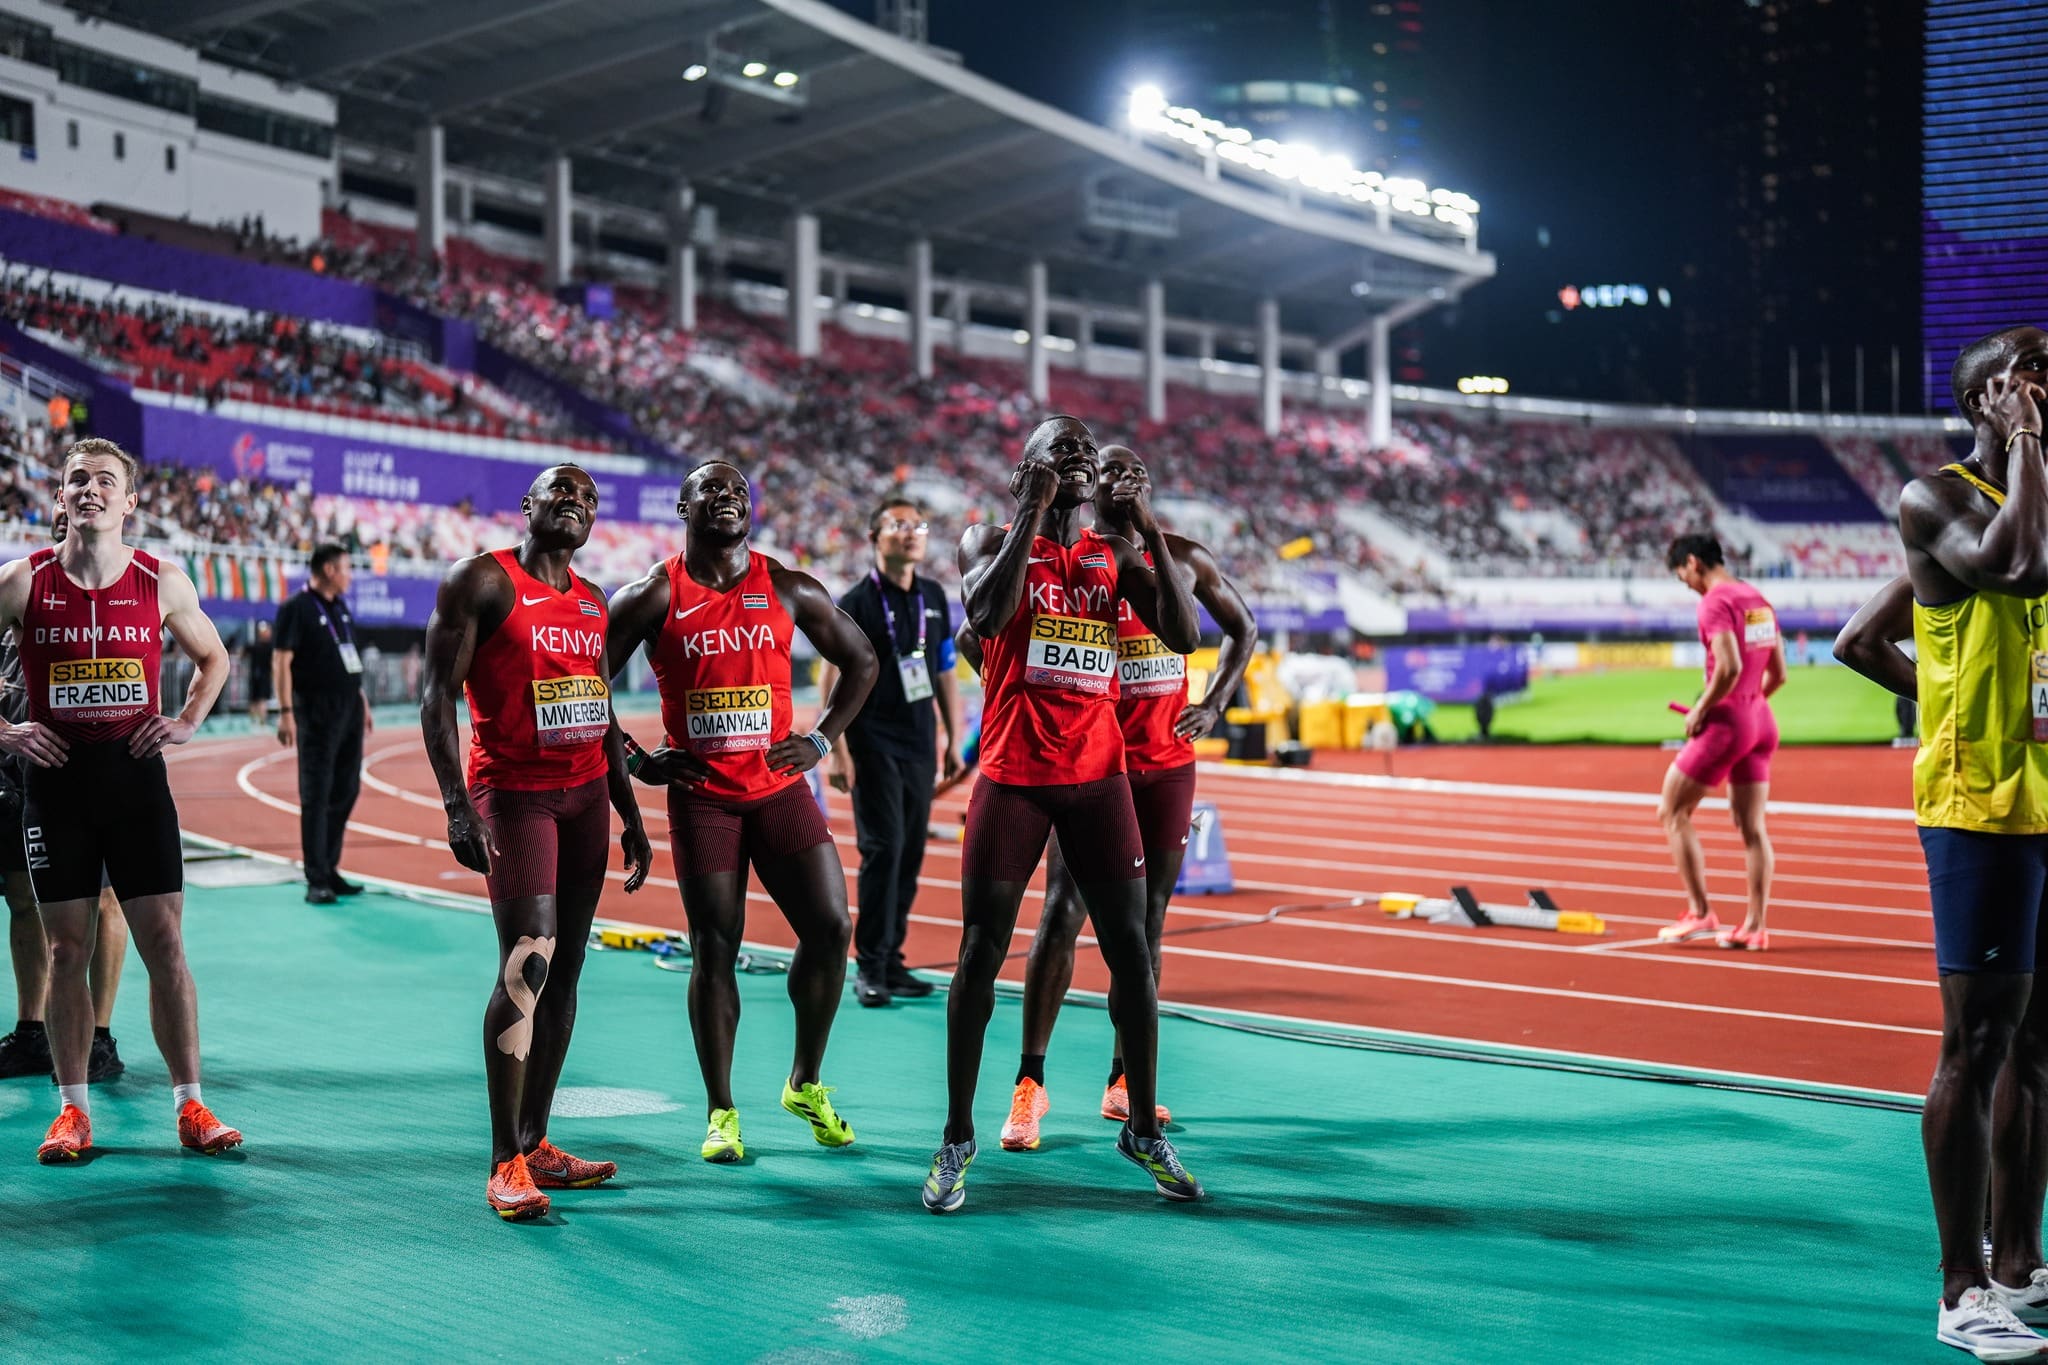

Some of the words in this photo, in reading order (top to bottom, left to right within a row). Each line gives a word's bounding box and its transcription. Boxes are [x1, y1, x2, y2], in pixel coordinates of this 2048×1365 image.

[1028, 581, 1113, 614] KENYA
[35, 625, 151, 644] DENMARK
[531, 624, 602, 659] KENYA
[683, 624, 776, 659] KENYA
[1035, 617, 1117, 647] SEIKO
[1043, 644, 1110, 673] BABU
[1117, 637, 1171, 658] EIK
[53, 661, 141, 682] SEIKO
[1122, 657, 1183, 681] ODHIAMBO
[55, 683, 143, 705] FRÆNDE
[537, 678, 606, 701] SEIKO
[688, 689, 769, 711] SEIKO
[77, 708, 133, 719] GUANGZHOU
[541, 701, 607, 727] MWERESA
[691, 711, 768, 736] OMANYALA
[27, 826, 50, 870] DEN
